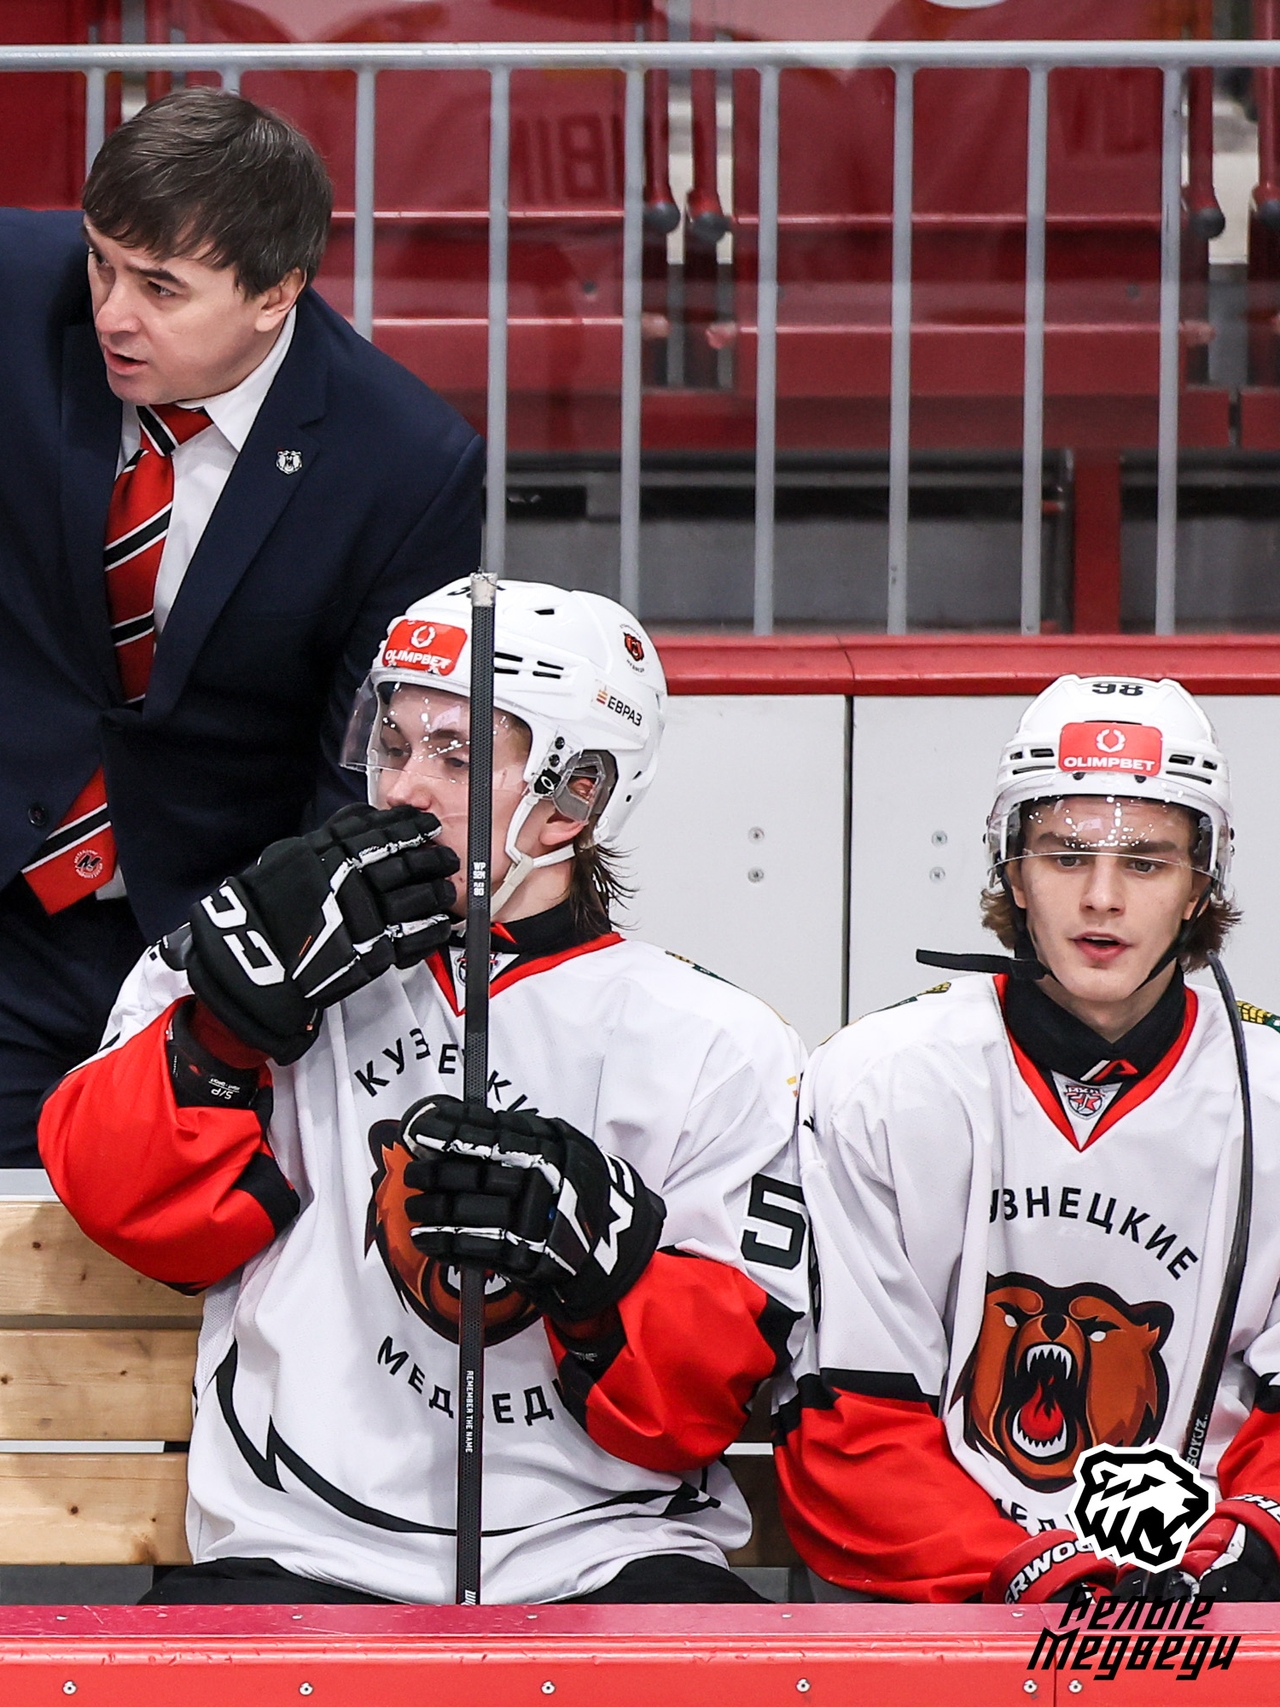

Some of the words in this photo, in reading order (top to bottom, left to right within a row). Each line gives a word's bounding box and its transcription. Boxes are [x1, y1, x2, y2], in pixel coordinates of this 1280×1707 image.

[385, 649, 451, 668] OLIMPBET
[1091, 683, 1144, 696] 98
[606, 696, 643, 727] ЕВРАЗ
[1063, 756, 1155, 771] OLIMPBET
[200, 880, 286, 987] CC
[465, 1370, 474, 1413] REMEMBER
[465, 1415, 473, 1430] THE
[465, 1431, 473, 1454] NAME
